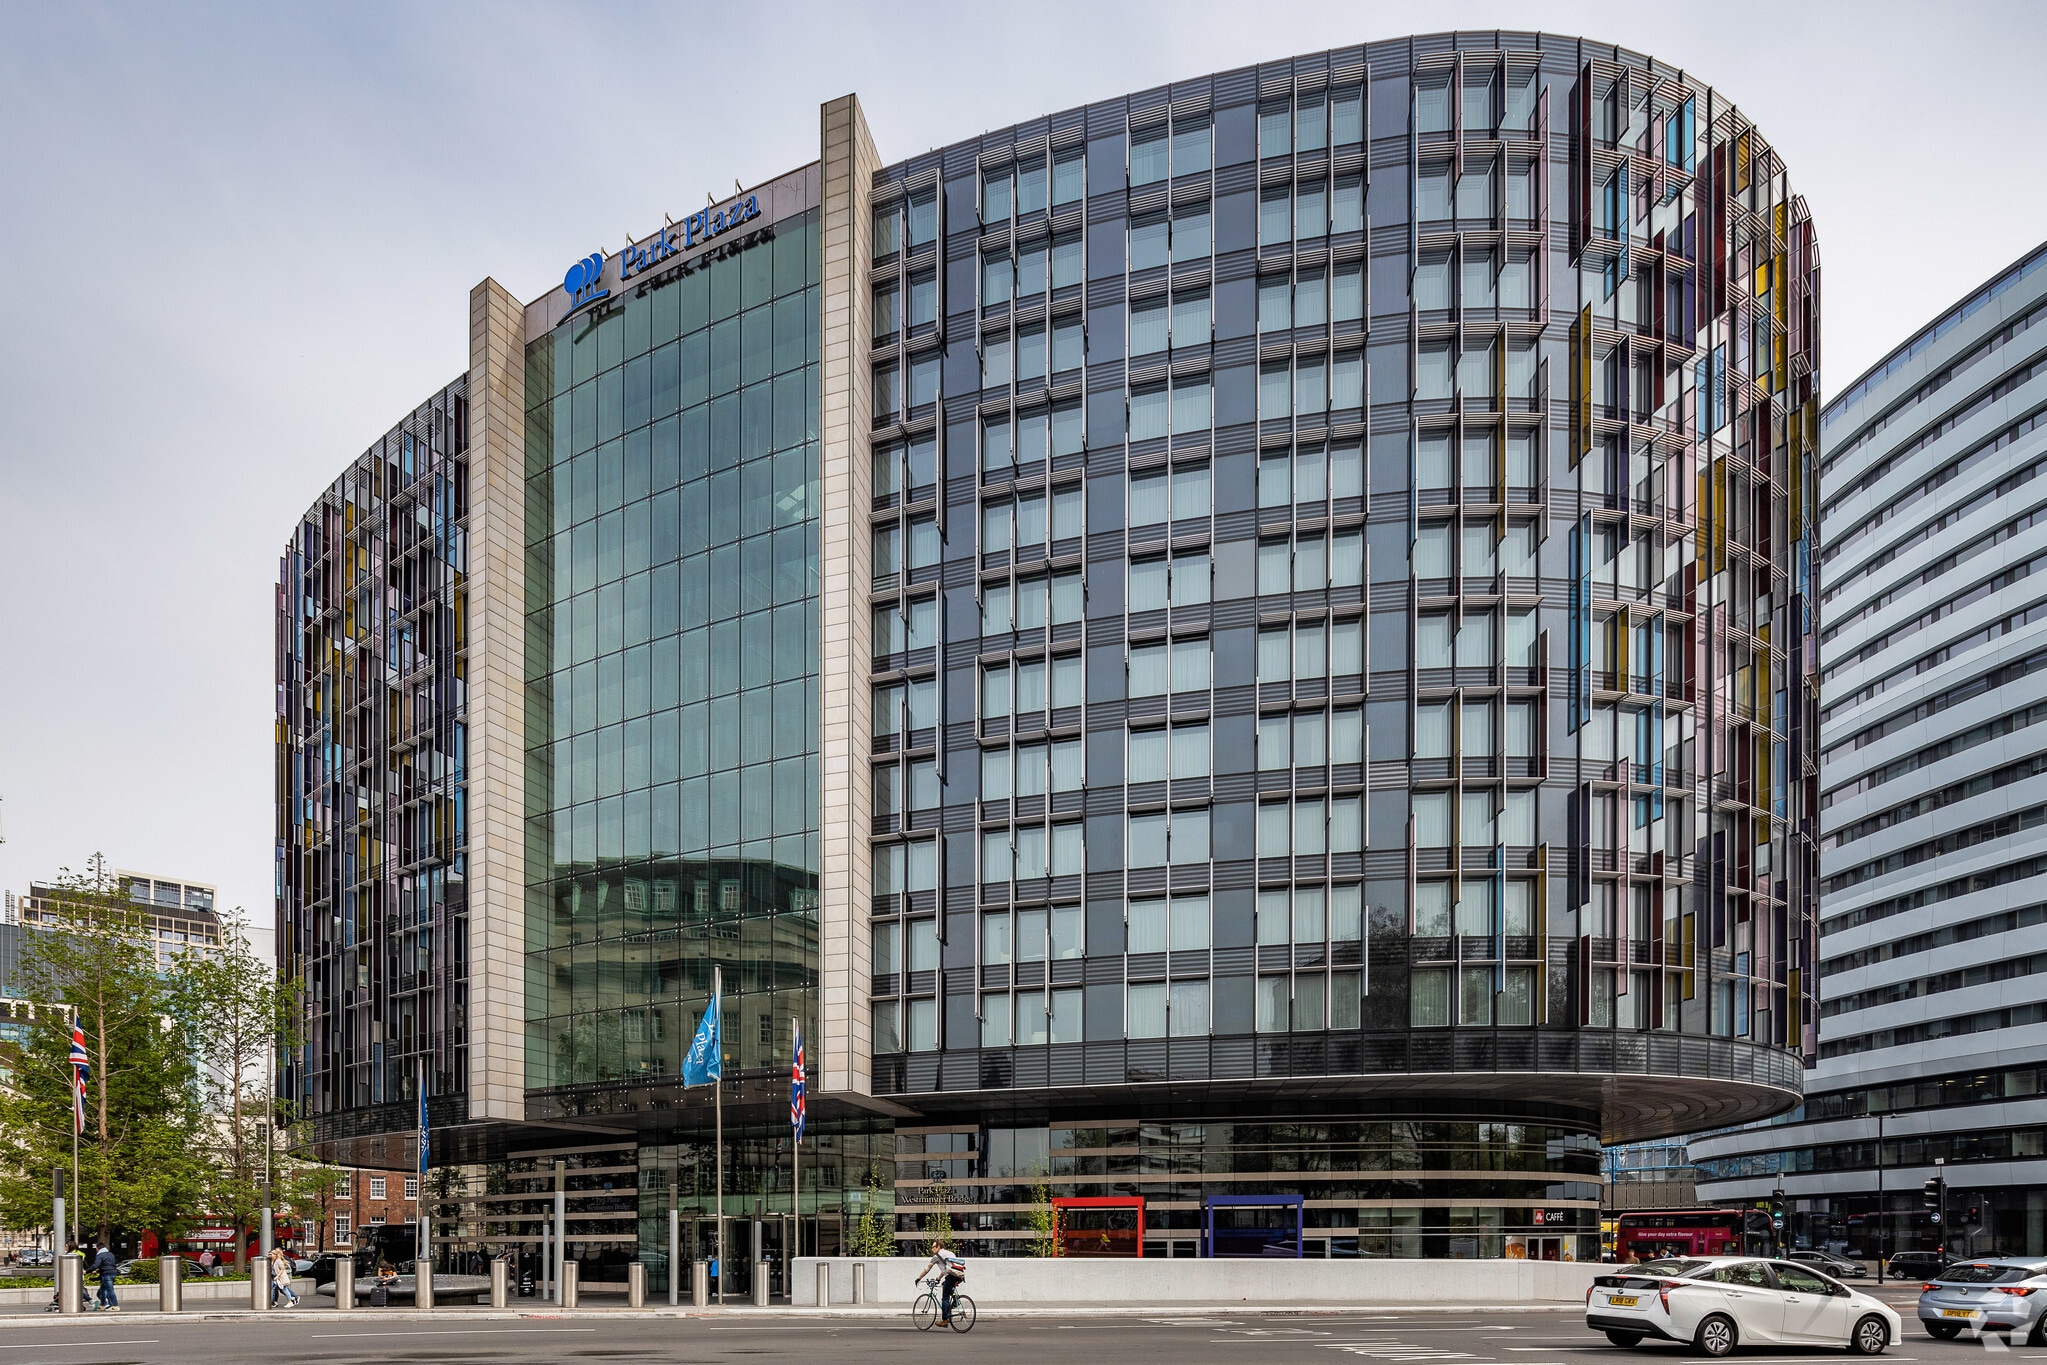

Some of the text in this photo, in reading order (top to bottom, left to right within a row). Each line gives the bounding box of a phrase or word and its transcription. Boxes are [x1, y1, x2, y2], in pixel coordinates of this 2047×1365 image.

[620, 195, 761, 281] Park Plaza
[918, 1186, 934, 1195] Park
[901, 1194, 974, 1205] Westminster Bridge
